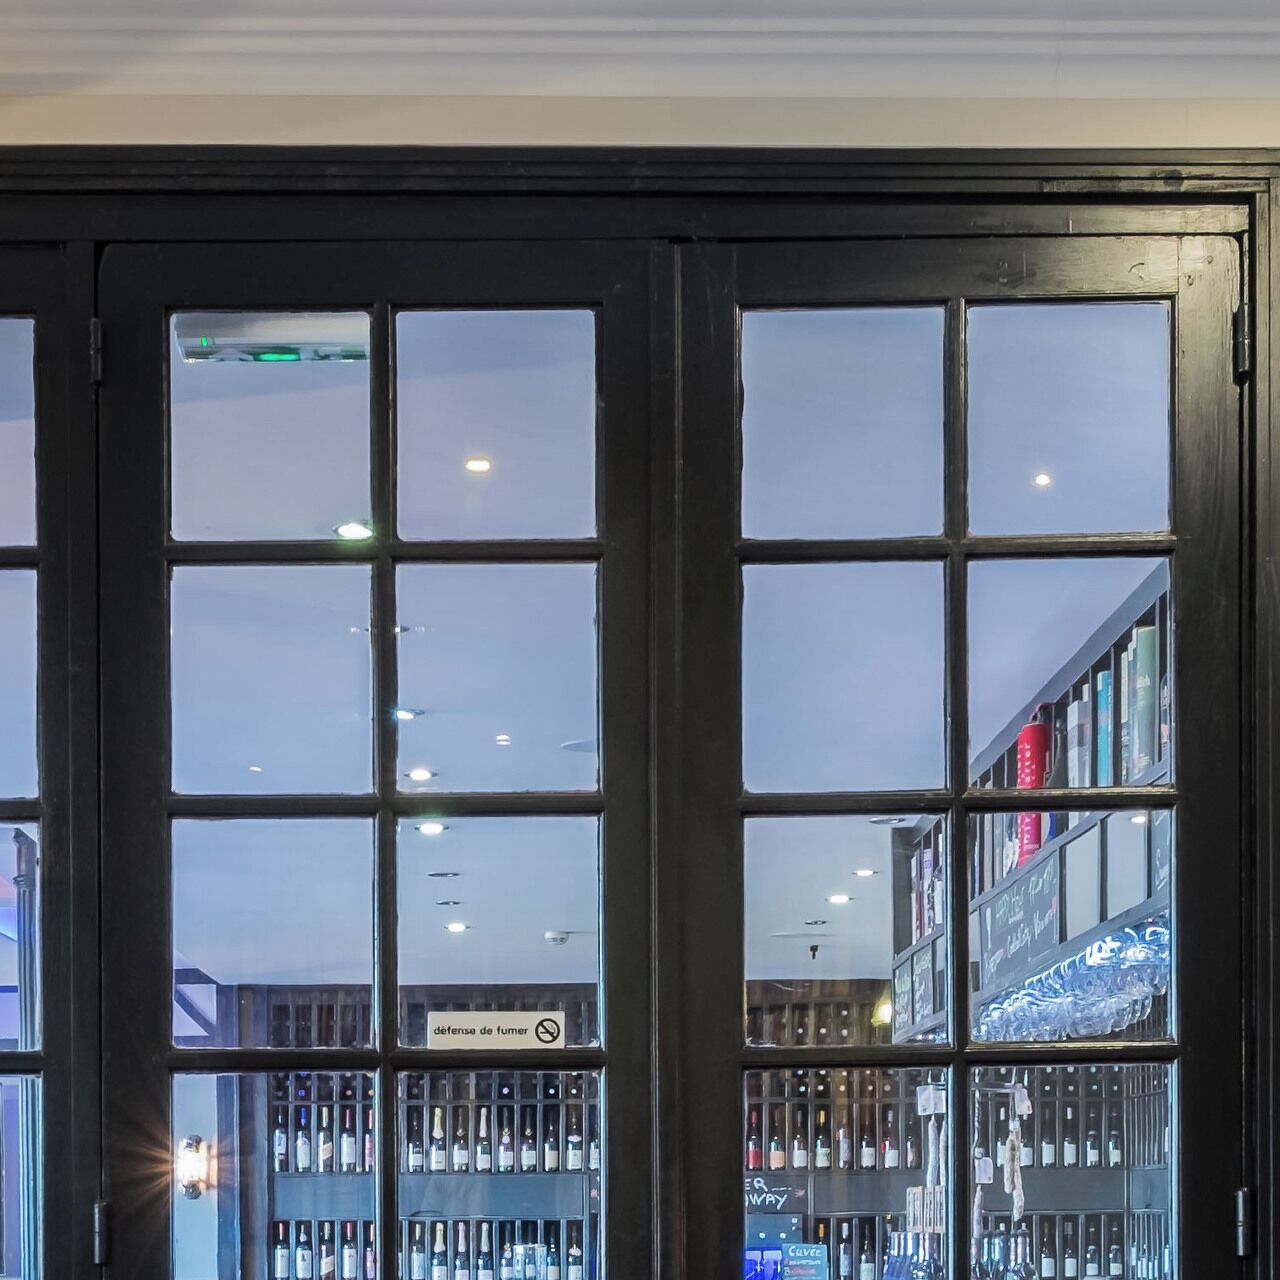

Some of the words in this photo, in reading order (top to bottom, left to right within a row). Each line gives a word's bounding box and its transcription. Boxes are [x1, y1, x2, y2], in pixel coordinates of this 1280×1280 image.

[433, 1025, 476, 1036] défense
[479, 1025, 493, 1036] de
[497, 1025, 529, 1036] fumer
